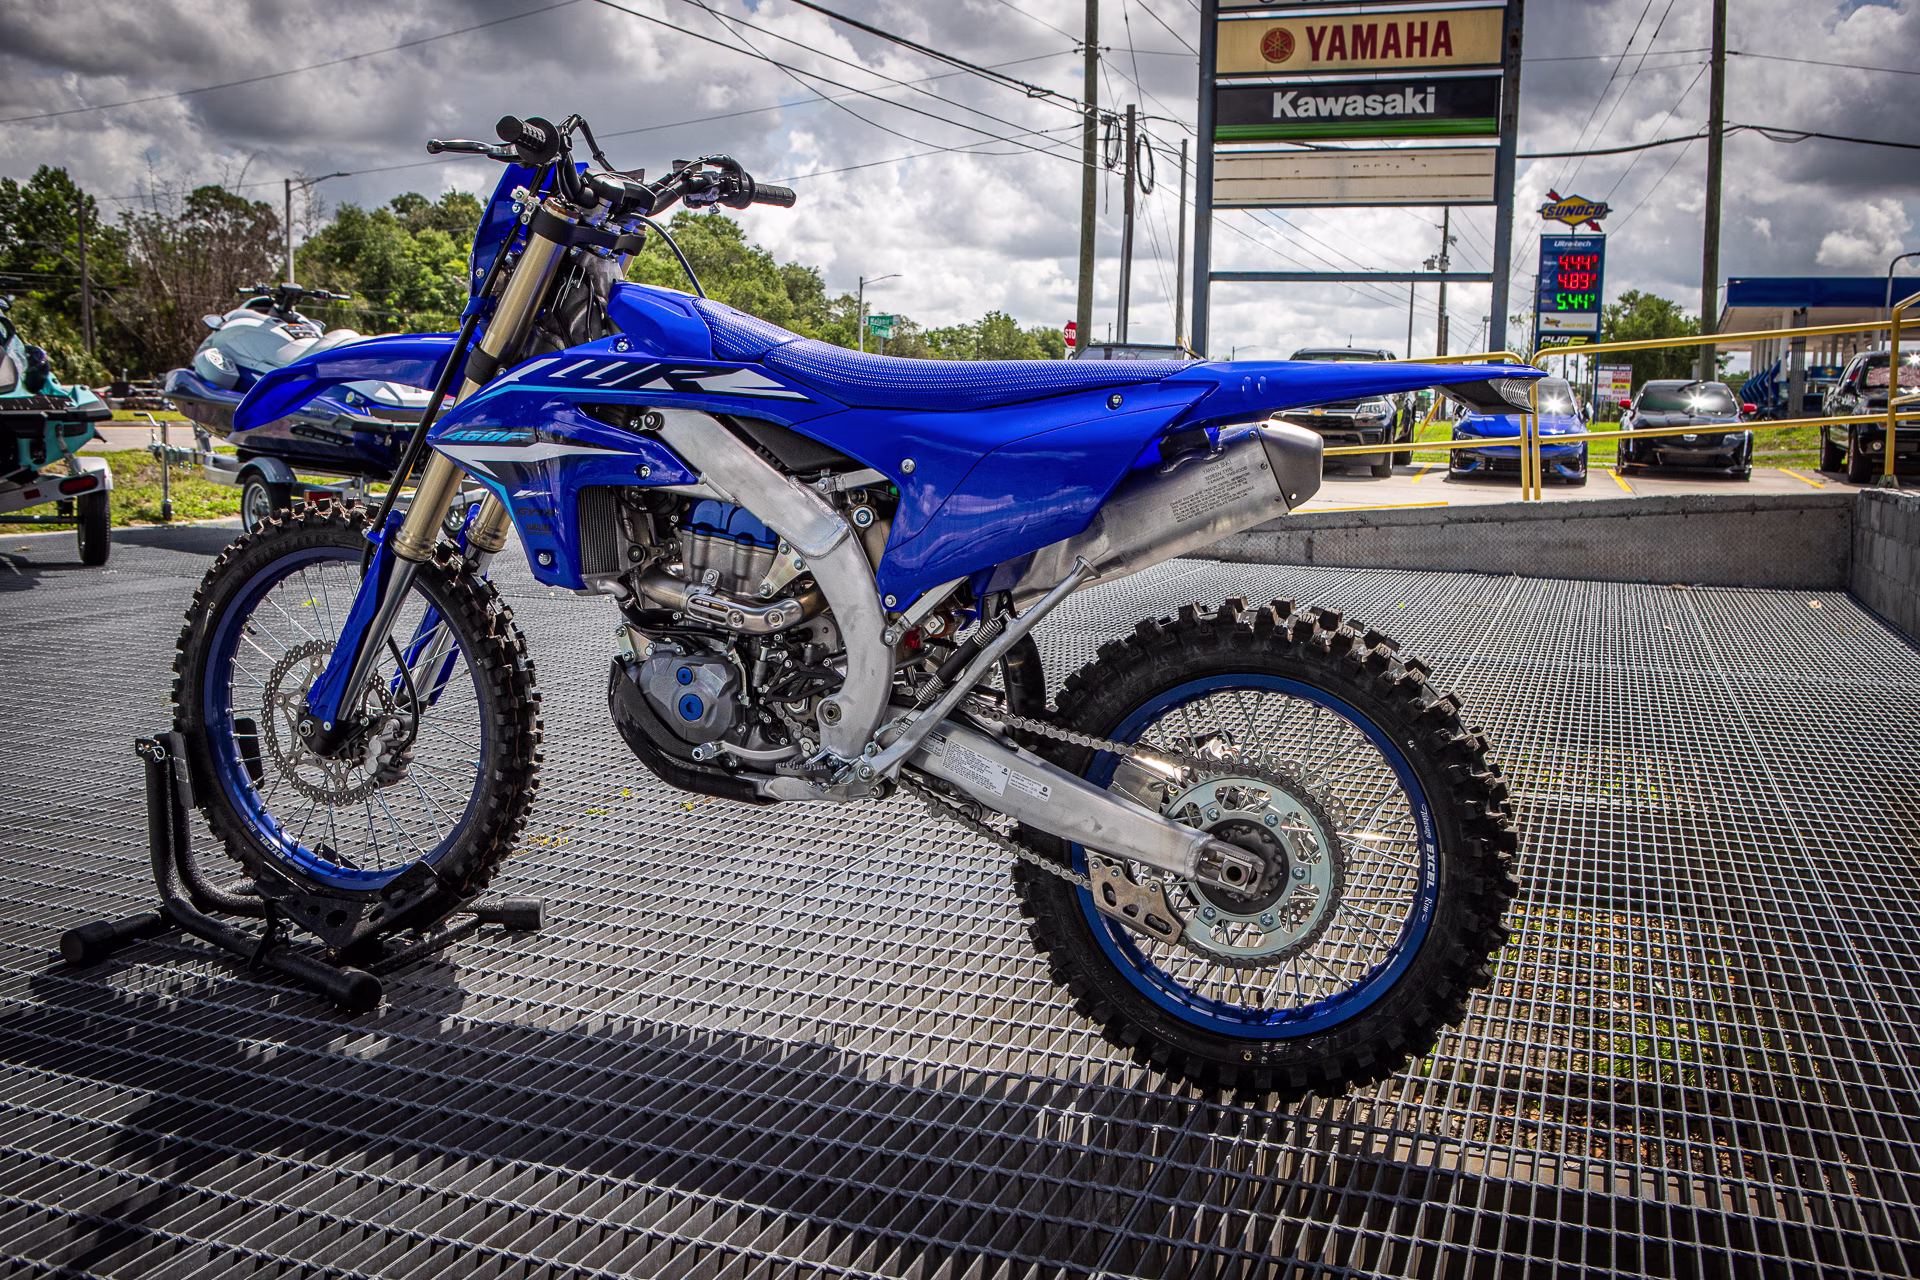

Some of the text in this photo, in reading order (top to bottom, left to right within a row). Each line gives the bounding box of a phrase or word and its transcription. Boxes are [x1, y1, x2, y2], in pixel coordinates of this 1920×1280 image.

[1305, 20, 1453, 62] YAMAHA
[1272, 86, 1436, 119] Kawasaki
[1545, 204, 1605, 217] SUNOCO
[1064, 328, 1076, 340] STO
[442, 430, 533, 443] 450F
[259, 833, 286, 860] EXCEL
[1426, 843, 1435, 889] EXCEL
